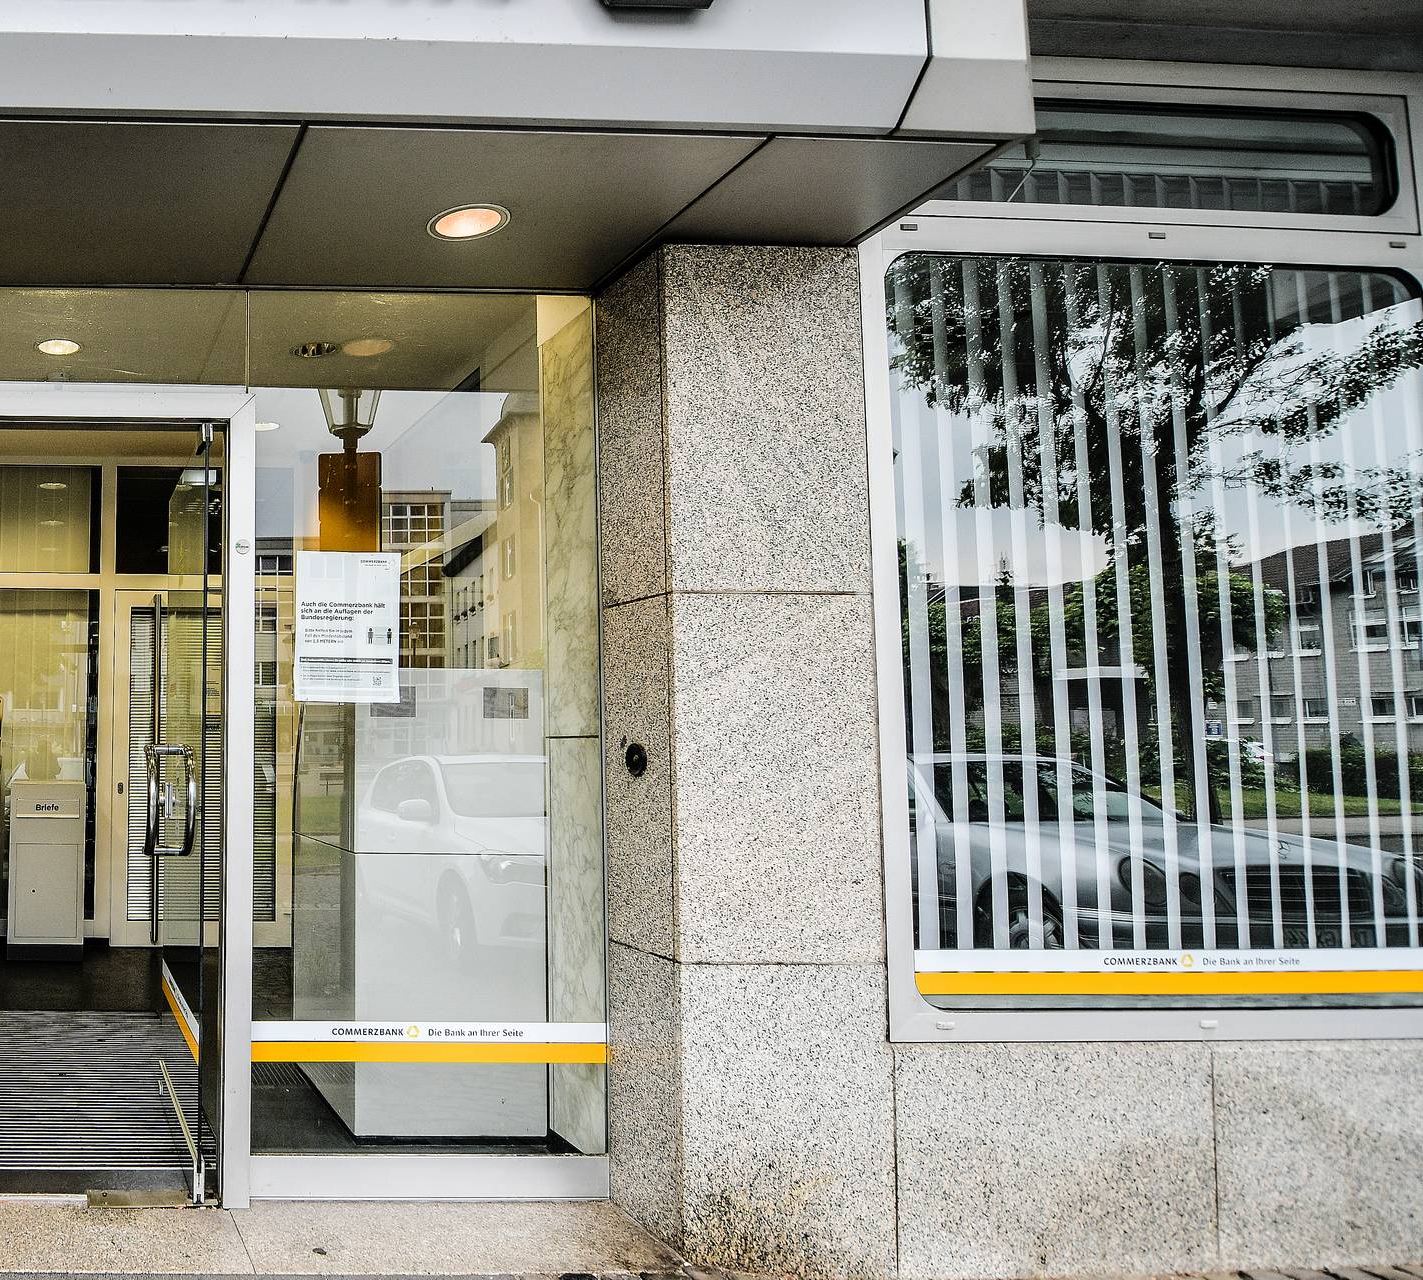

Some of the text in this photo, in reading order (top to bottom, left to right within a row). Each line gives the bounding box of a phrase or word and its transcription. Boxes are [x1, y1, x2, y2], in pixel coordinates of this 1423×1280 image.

[1103, 958, 1177, 966] COMMERZBANK
[1203, 957, 1217, 966] Die
[1220, 957, 1240, 966] Bank
[1256, 958, 1275, 966] Ihrer
[1278, 958, 1300, 966] Seite
[332, 1028, 404, 1036] COMMERZBANK
[428, 1028, 442, 1037] Die
[444, 1029, 465, 1037] Bank
[480, 1029, 500, 1037] Ihrer
[503, 1029, 524, 1037] Seite
